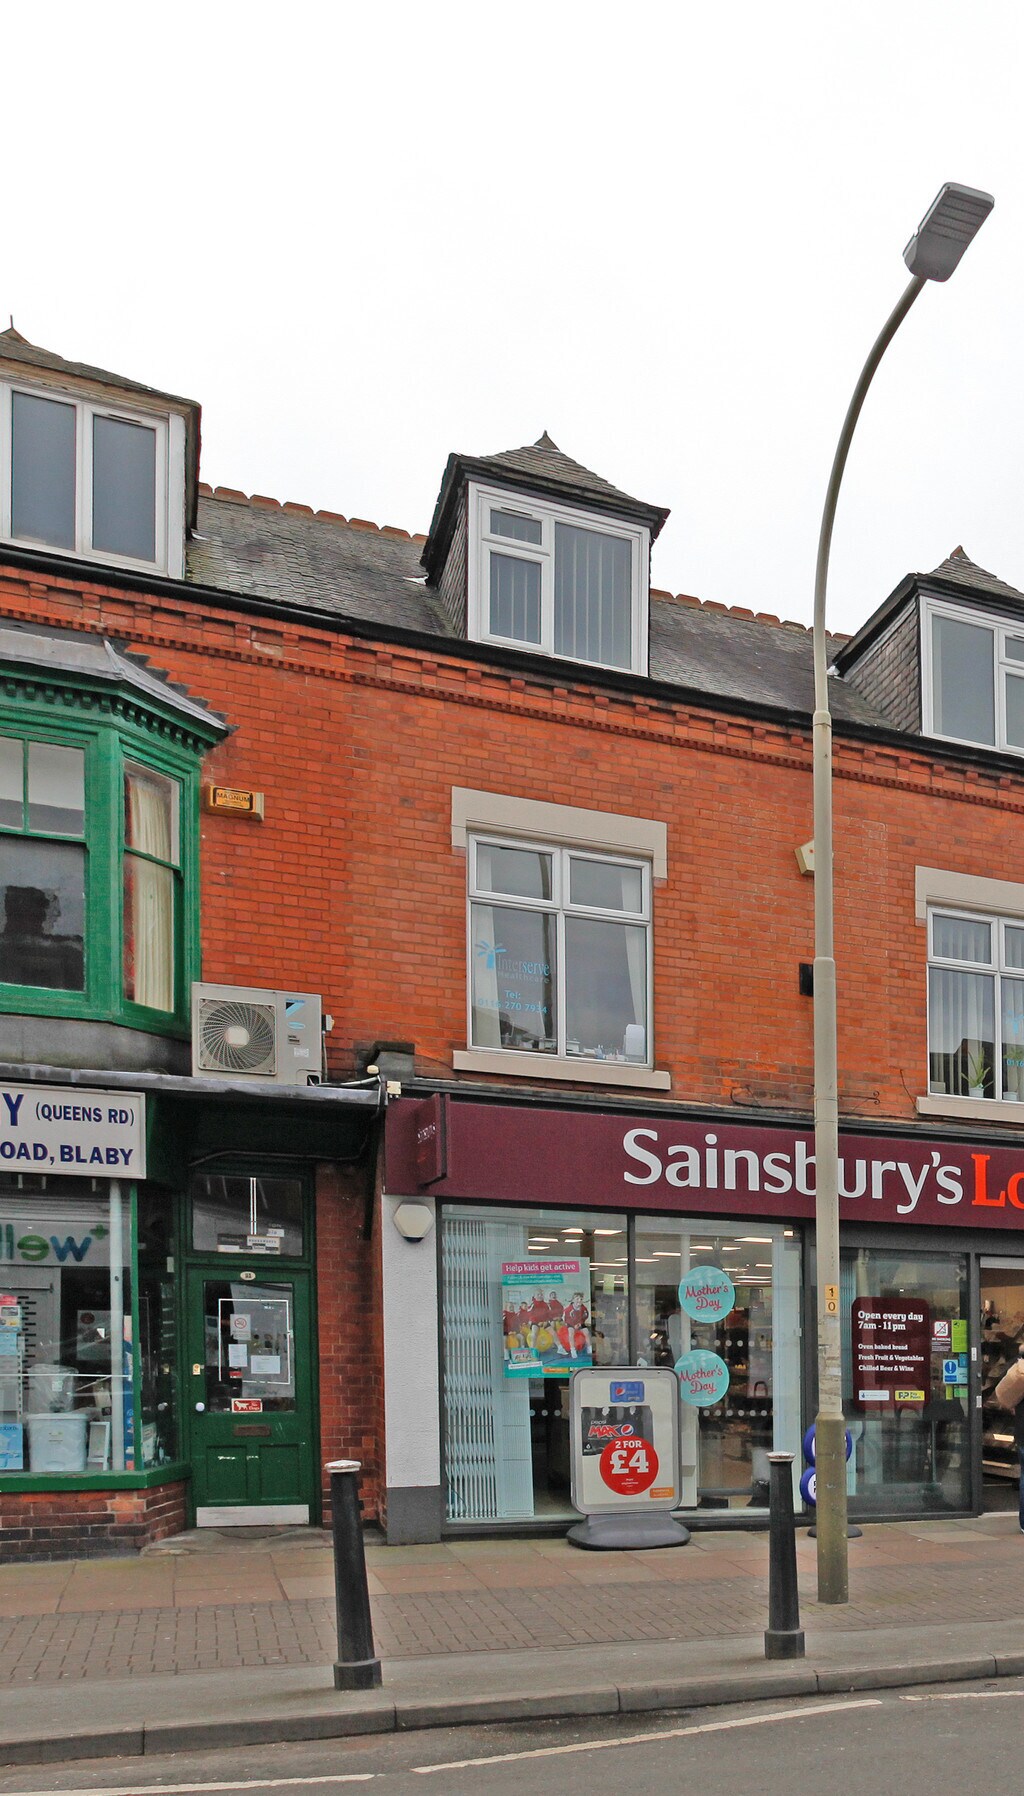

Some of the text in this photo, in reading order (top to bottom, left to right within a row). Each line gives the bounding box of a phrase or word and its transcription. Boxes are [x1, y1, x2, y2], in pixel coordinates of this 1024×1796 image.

[505, 1001, 521, 1011] 270
[525, 1003, 547, 1014] 7934
[2, 1093, 24, 1126] Y
[35, 1102, 134, 1126] (QUEENS RD)
[60, 1144, 133, 1166] BLABY
[622, 1128, 964, 1215] Sainsbury's
[505, 1262, 576, 1273] Help kids get active
[685, 1282, 729, 1299] Mother's
[828, 1286, 834, 1298] 1
[695, 1296, 723, 1312] Day
[858, 1310, 924, 1323] Open every day
[857, 1321, 877, 1330] 7am
[882, 1321, 906, 1332] 11pm
[894, 1354, 924, 1362] Vegetables
[679, 1364, 723, 1381] Mother's
[690, 1380, 717, 1394] Day
[588, 1424, 622, 1438] MAX
[615, 1440, 642, 1448] 2 FOR
[610, 1449, 649, 1475] £4
